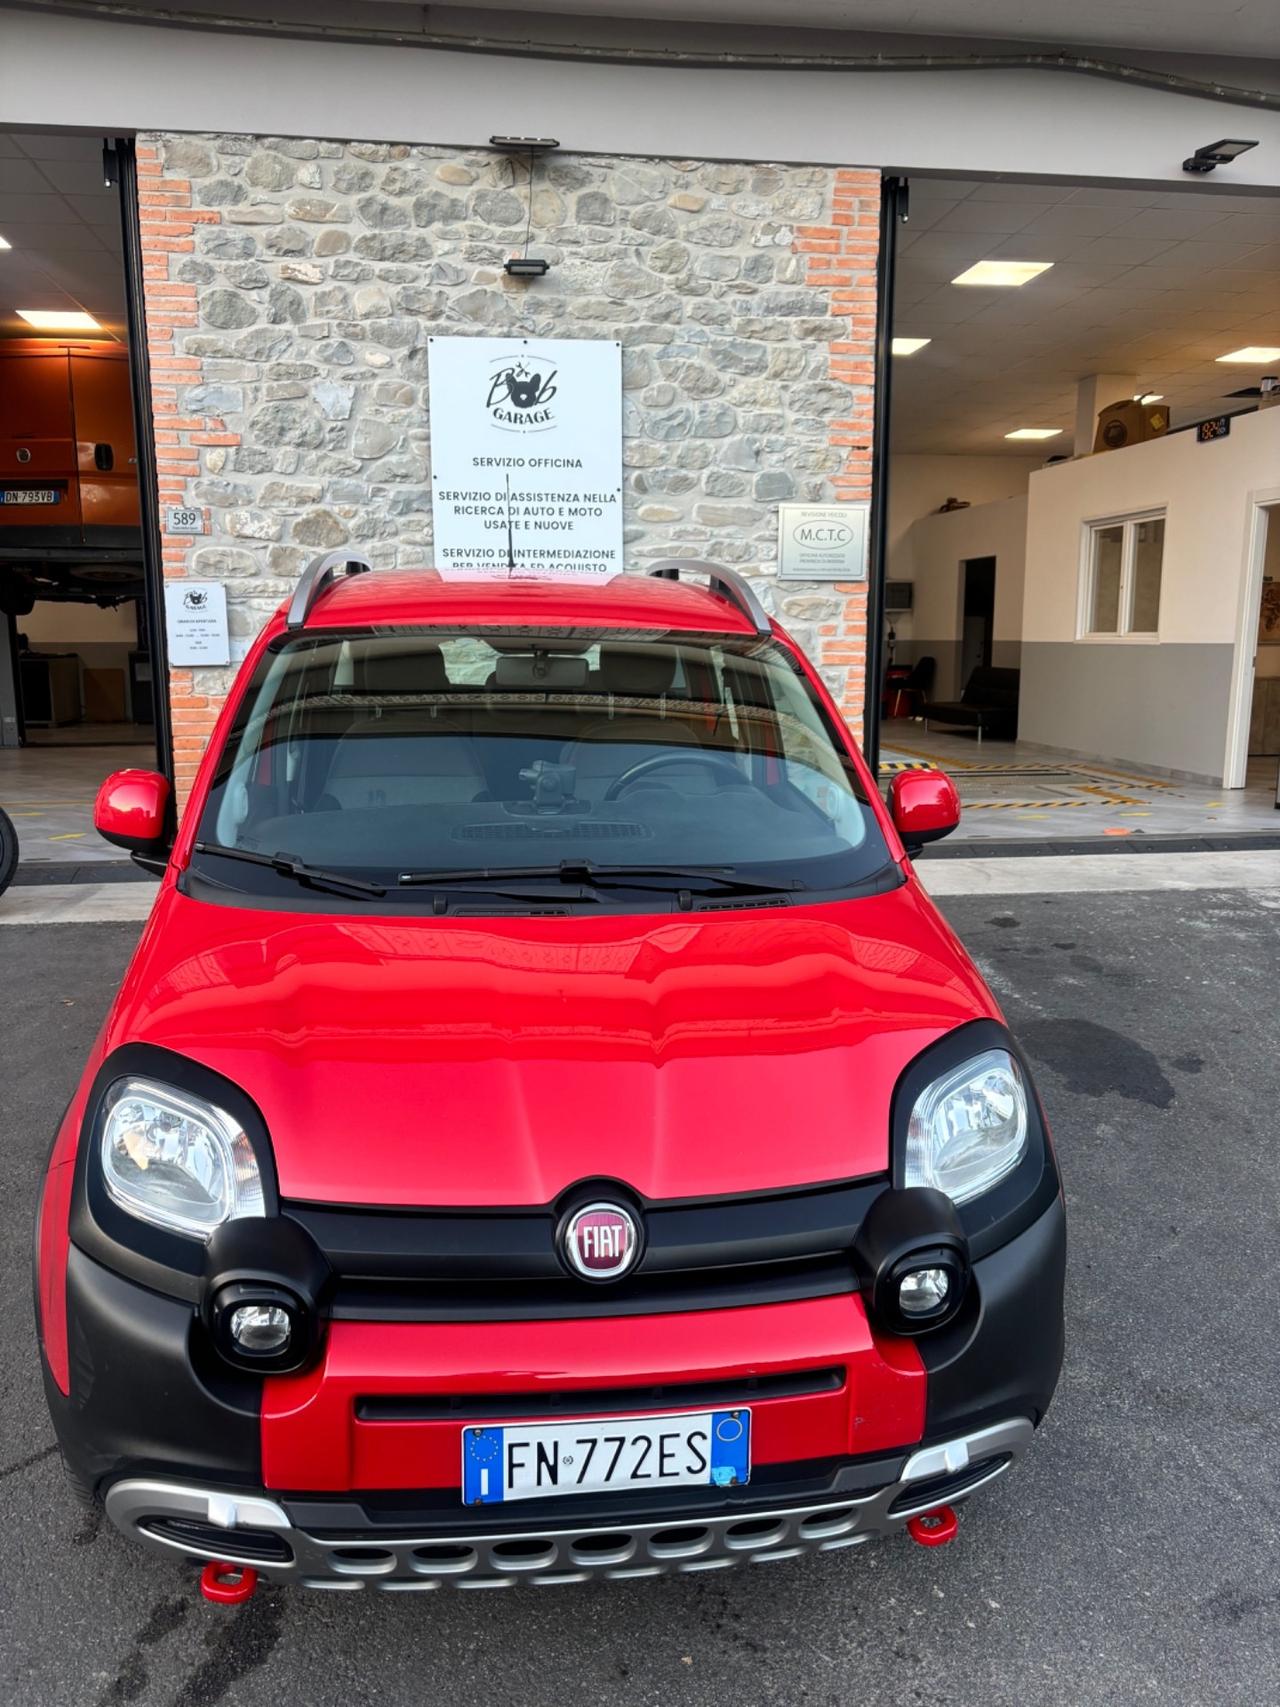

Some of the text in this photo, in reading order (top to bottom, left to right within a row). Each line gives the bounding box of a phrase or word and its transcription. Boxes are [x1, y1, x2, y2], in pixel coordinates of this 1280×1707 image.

[493, 407, 555, 425] GARAGE
[472, 457, 583, 468] SERVIZIO OFFICINA
[438, 491, 617, 503] SERVIZIO DI ASSISTENZA NELLA
[454, 505, 603, 517] RICERCA DI AUTO E MOTO
[173, 512, 196, 526] 589
[484, 520, 574, 531] USATE E NUOVE
[442, 548, 495, 558] SERVIZIO
[513, 549, 616, 559] INTERMEDIAZIONE
[583, 1225, 622, 1259] FIAT
